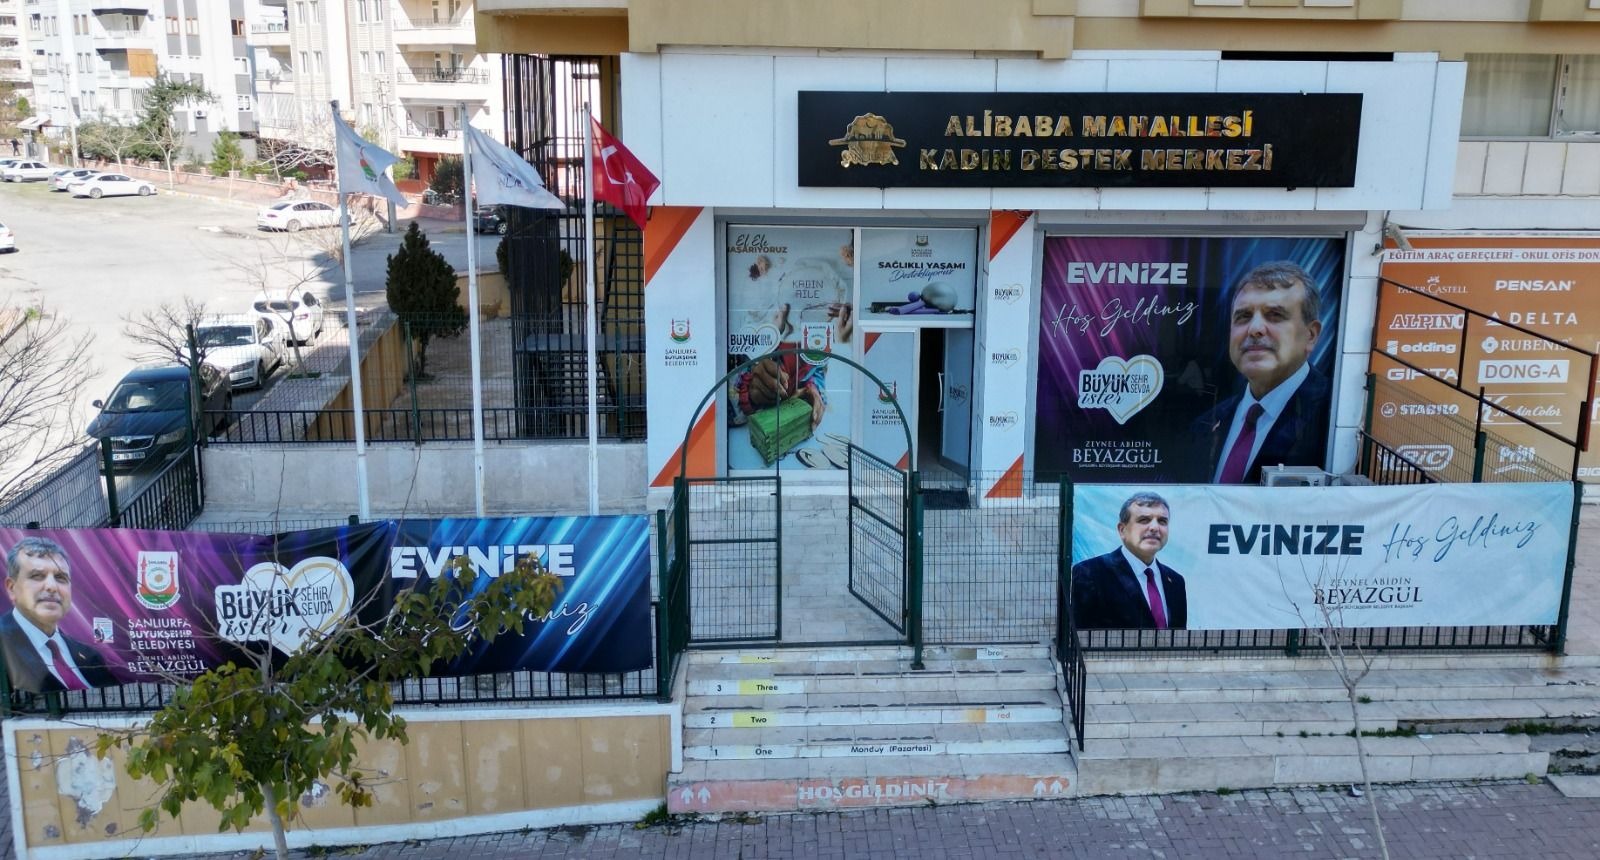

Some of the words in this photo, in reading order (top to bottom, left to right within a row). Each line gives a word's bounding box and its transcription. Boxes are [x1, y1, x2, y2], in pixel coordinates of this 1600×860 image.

[944, 110, 1074, 138] ALİBABA
[1082, 111, 1254, 138] MAHALLESİ
[919, 148, 1012, 171] KADIN
[1020, 148, 1134, 171] DESTEK
[1140, 144, 1275, 171] MERKEZİ
[1427, 251, 1455, 262] ARAÇ
[1456, 249, 1513, 262] GEREÇLERİ
[1521, 251, 1550, 260] OKUL
[1552, 249, 1576, 260] OFİS
[878, 260, 924, 270] SAĞLIKLI
[927, 262, 966, 271] YAŞAMI
[1495, 280, 1571, 291] PENSAN
[1051, 303, 1095, 338] Hoş
[1100, 295, 1199, 337] Geldiniz
[1389, 314, 1465, 329] ALPINO
[1510, 312, 1578, 325] DELTA
[730, 334, 760, 346] BÜYÜK
[1401, 341, 1457, 354] edding
[1485, 364, 1561, 379] DONG-A
[1082, 374, 1131, 393] BÜYÜK
[1532, 405, 1562, 416] Color
[1072, 449, 1163, 464] BEYAZGÜL
[1383, 522, 1430, 563] Hoş
[1433, 513, 1542, 562] Geldiniz
[1313, 586, 1423, 605] BEYAZGÜL
[221, 588, 300, 619] BÜYÜK
[301, 601, 334, 616] SEVDA
[128, 618, 191, 630] ŞANLIURFA
[130, 639, 195, 649] BELEDİYESİ
[128, 659, 208, 673] BEYAZGÜL
